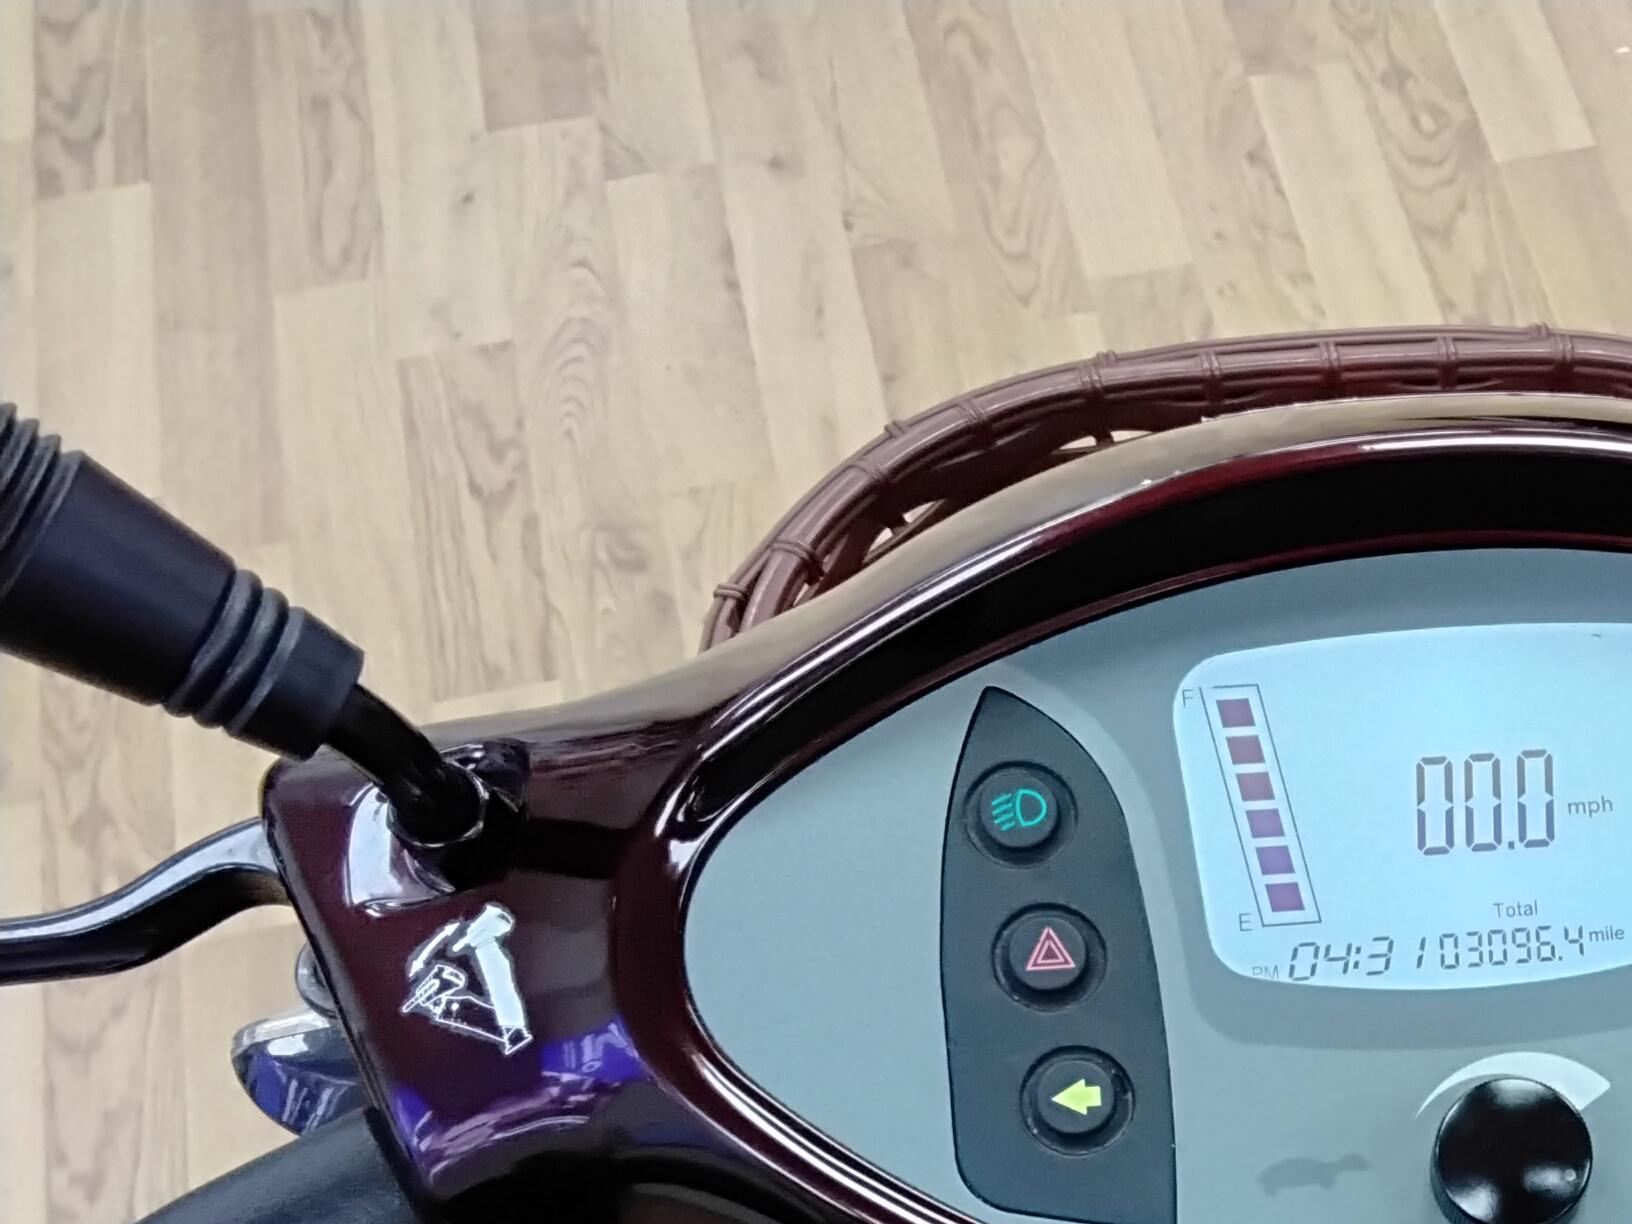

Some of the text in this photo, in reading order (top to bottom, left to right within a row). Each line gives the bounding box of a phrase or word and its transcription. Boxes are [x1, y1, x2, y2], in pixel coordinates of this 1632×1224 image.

[1181, 688, 1194, 708] F
[1416, 749, 1614, 856] 00.0 mph
[1493, 899, 1539, 918] Total
[1238, 913, 1253, 932] E
[1589, 925, 1626, 943] mile
